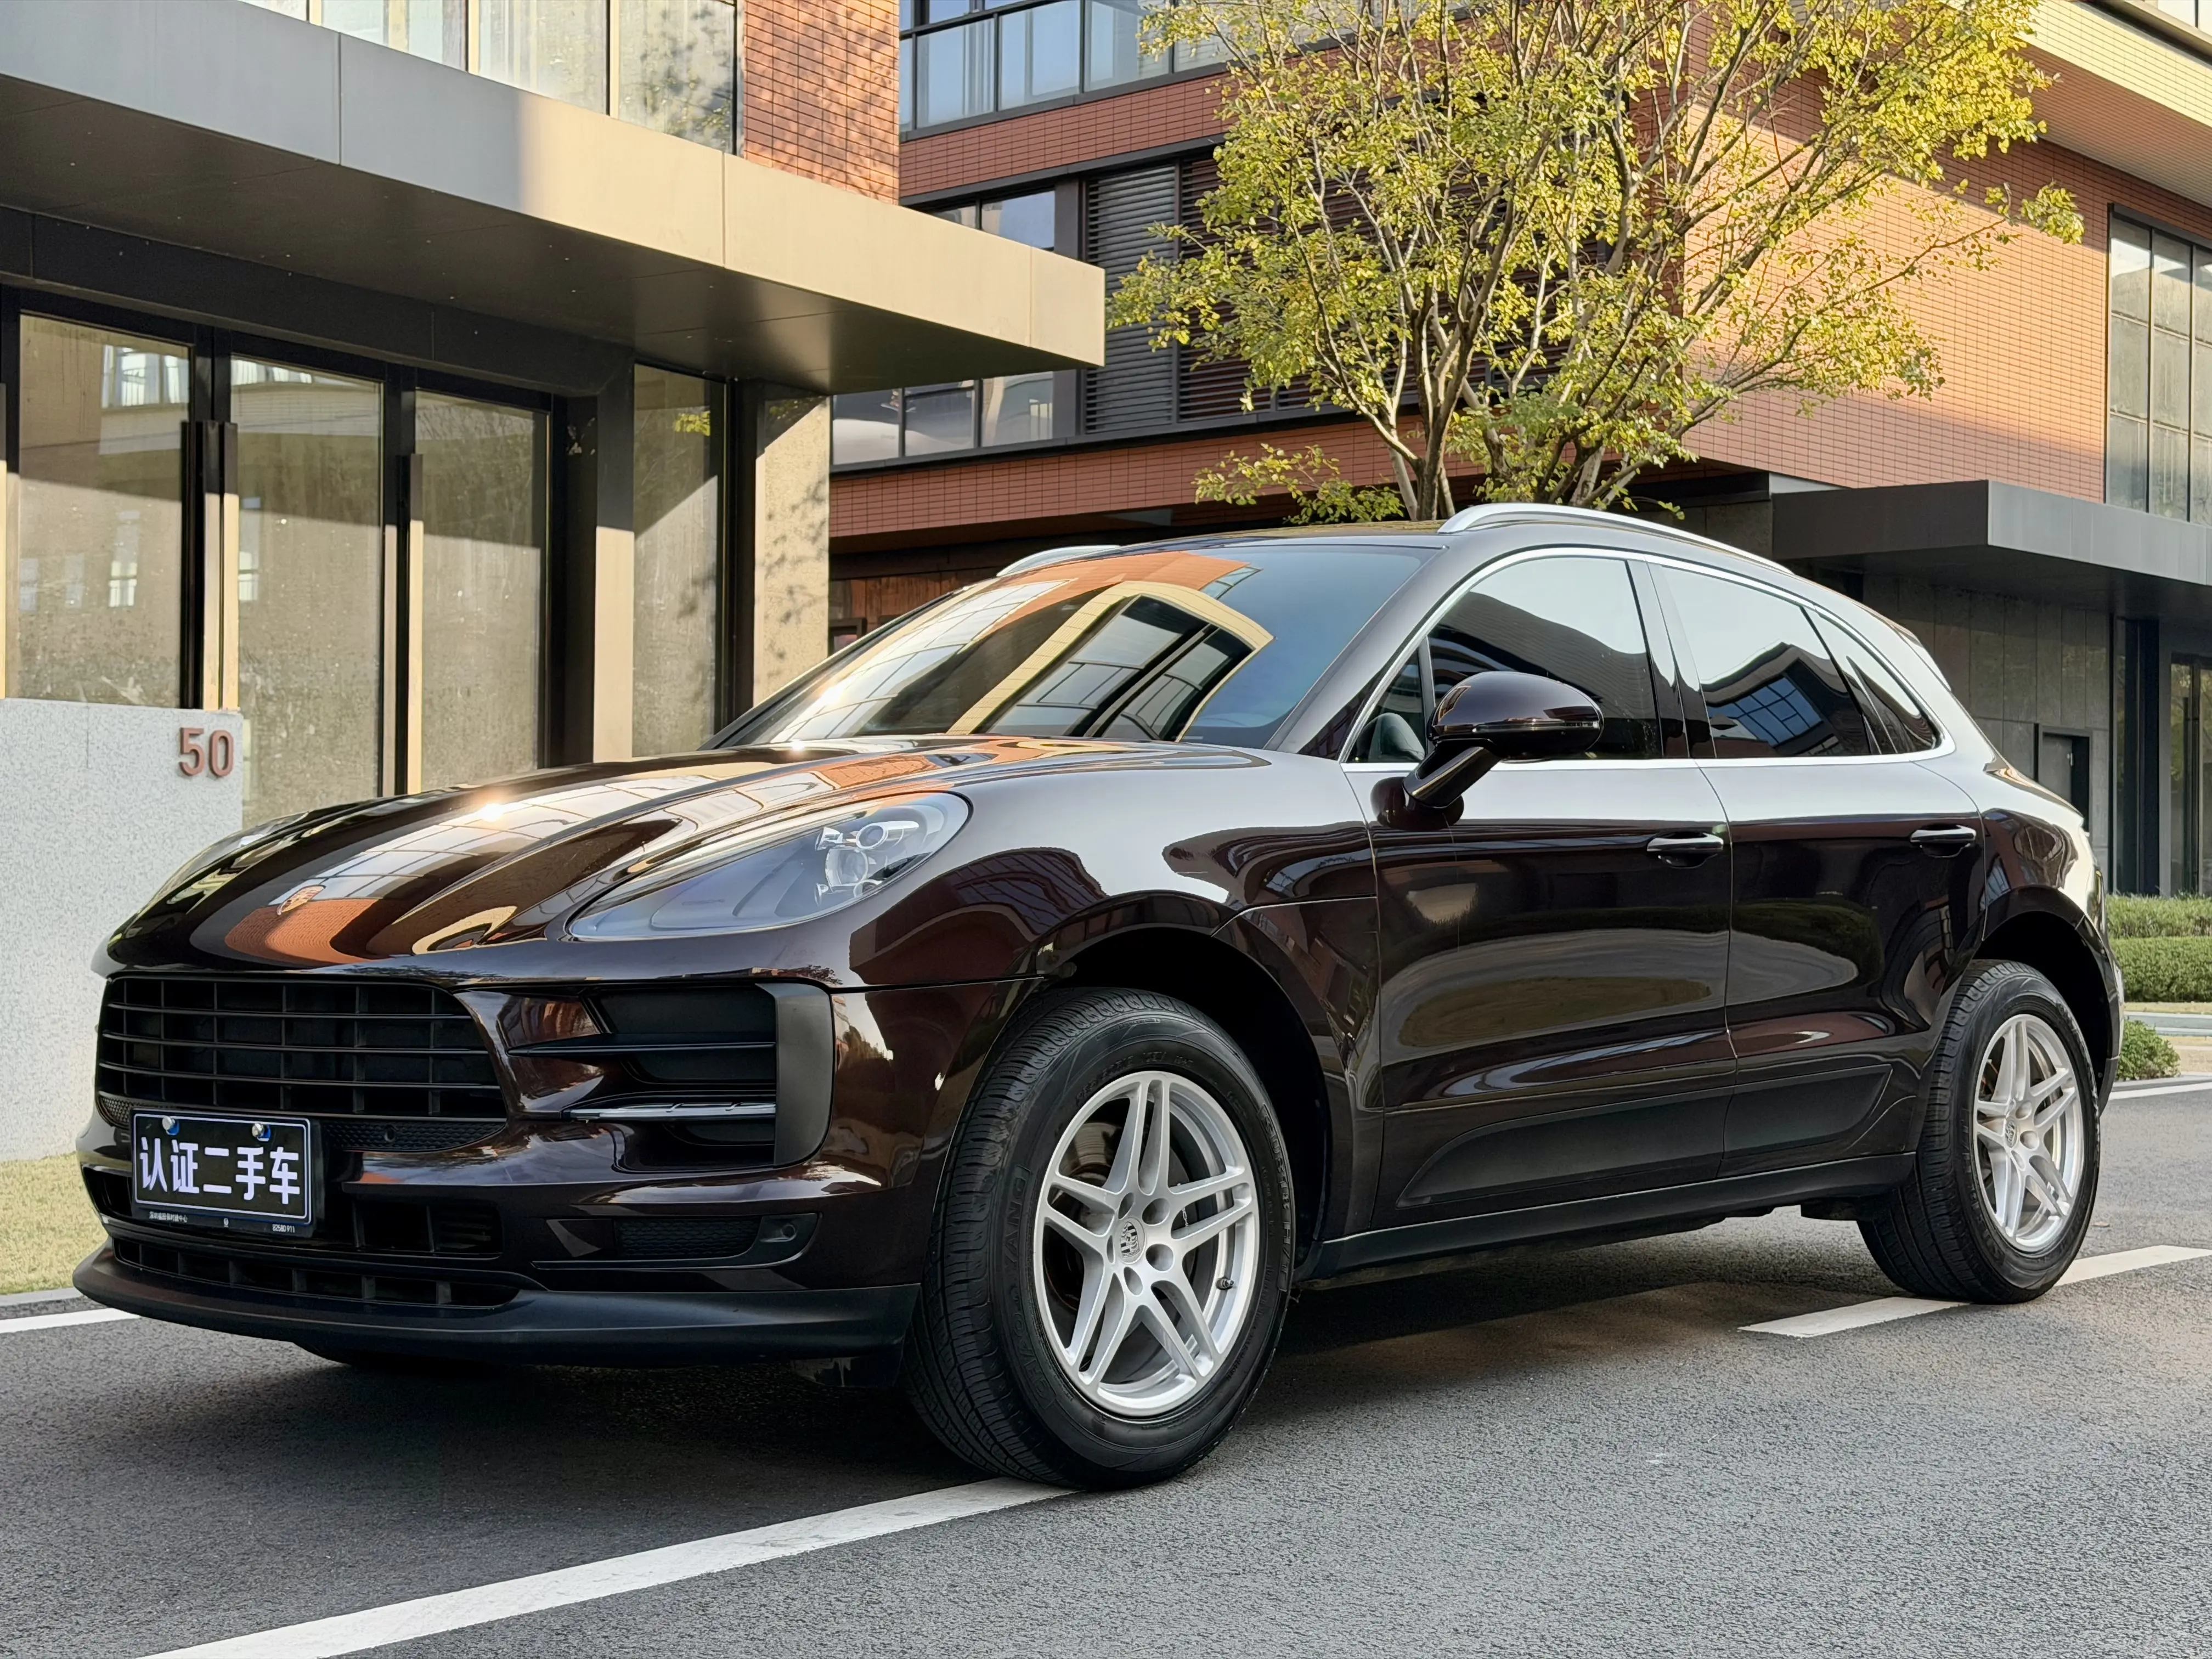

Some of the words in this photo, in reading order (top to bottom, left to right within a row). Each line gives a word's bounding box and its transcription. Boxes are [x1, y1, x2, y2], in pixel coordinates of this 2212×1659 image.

[178, 727, 233, 777] 50
[140, 1137, 300, 1204] 认证二手车
